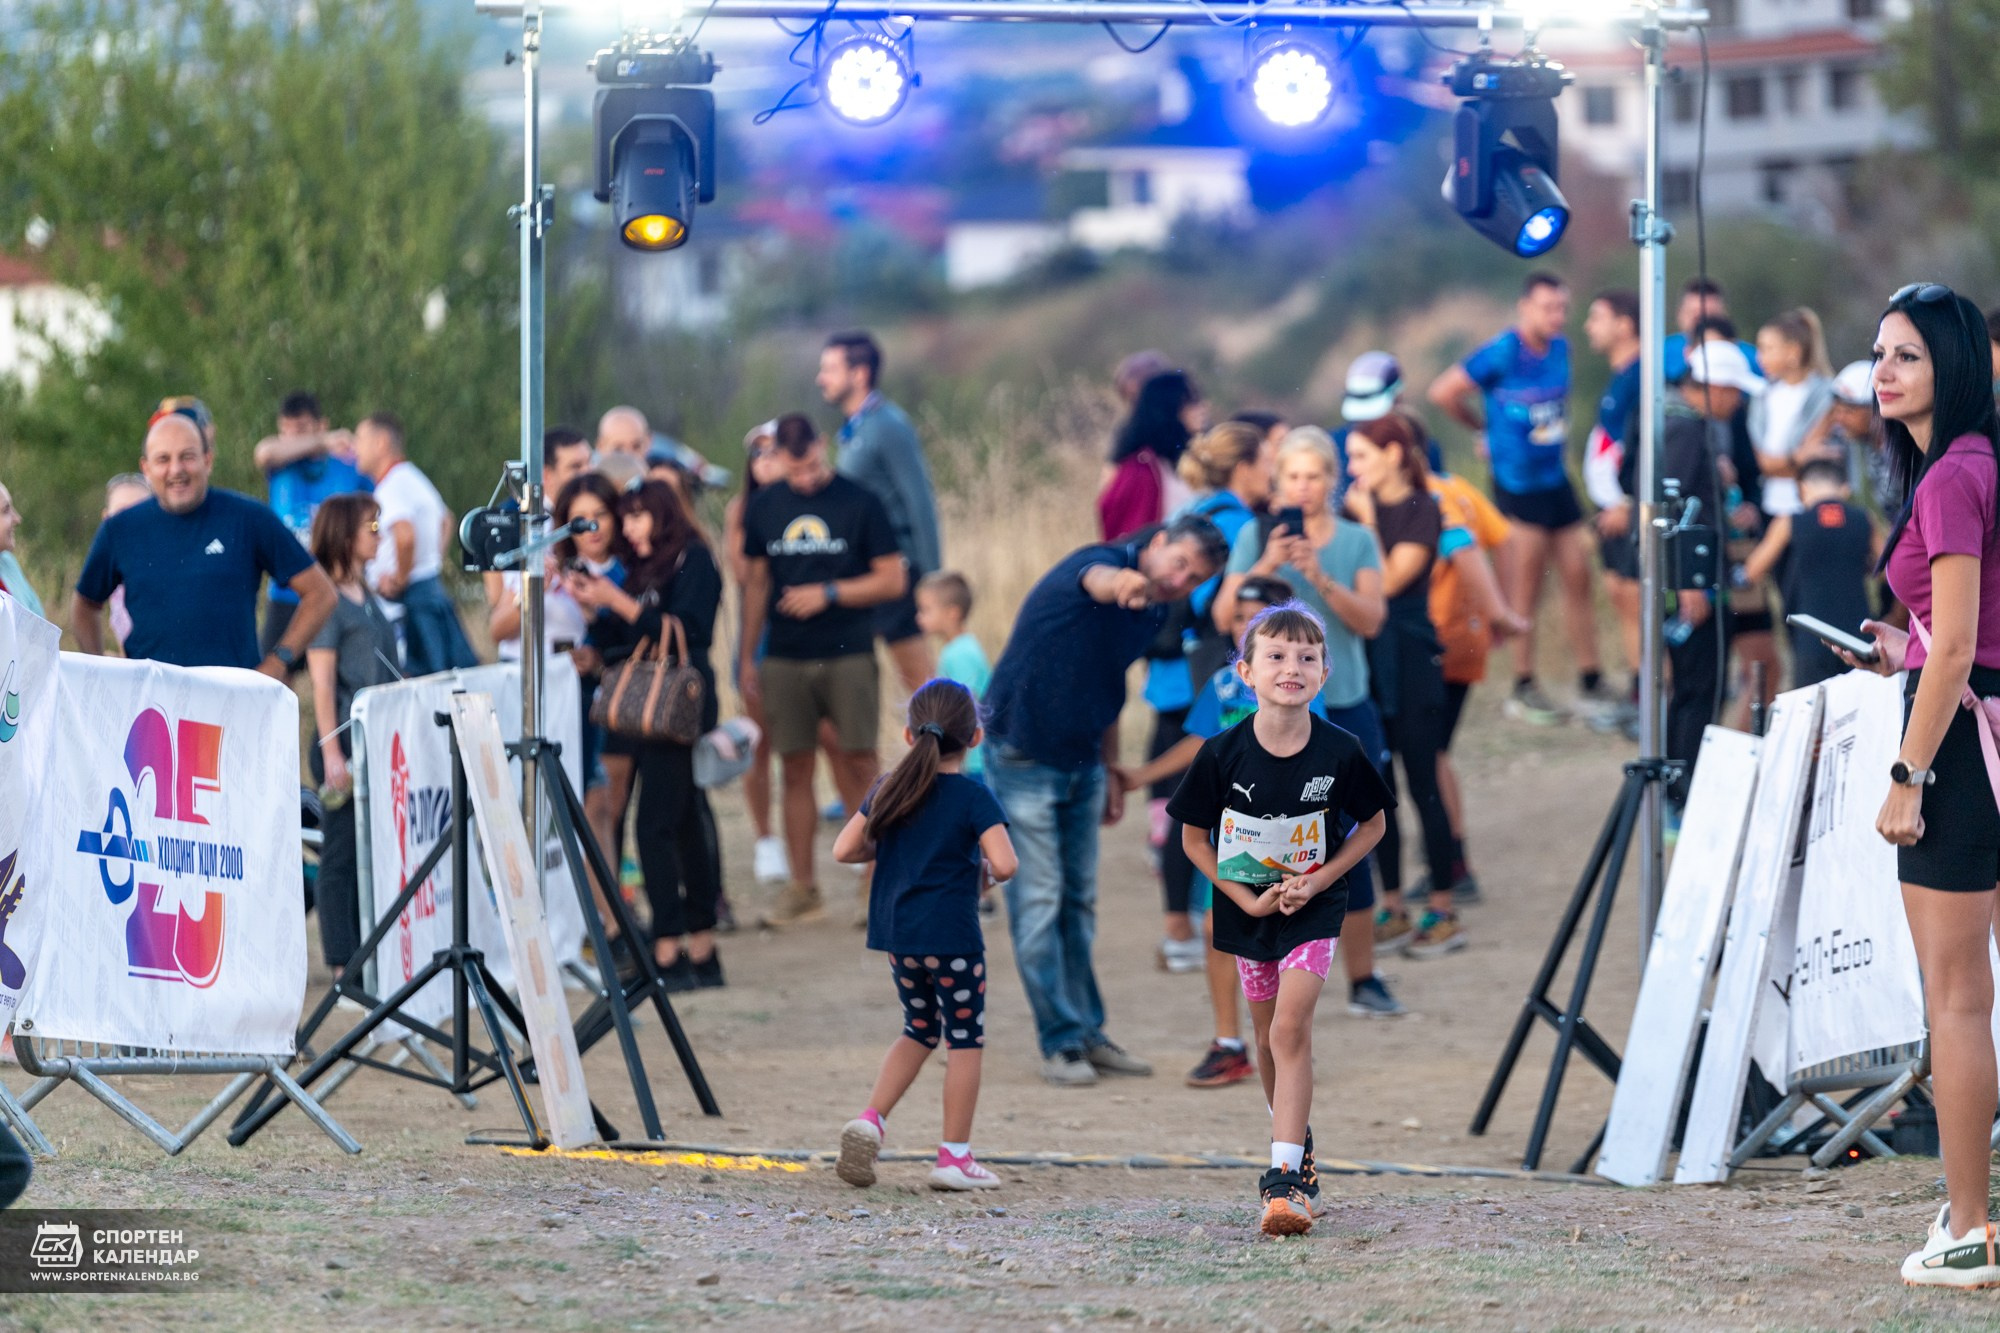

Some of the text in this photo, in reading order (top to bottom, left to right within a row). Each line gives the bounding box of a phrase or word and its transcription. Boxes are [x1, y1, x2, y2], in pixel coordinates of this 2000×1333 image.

[1235, 826, 1261, 838] PLOVDIV
[1235, 834, 1252, 843] HILLS
[1289, 819, 1320, 847] 44
[157, 835, 196, 878] ХОЛДИНГ
[219, 844, 244, 881] 2000
[1282, 848, 1318, 864] KIDS
